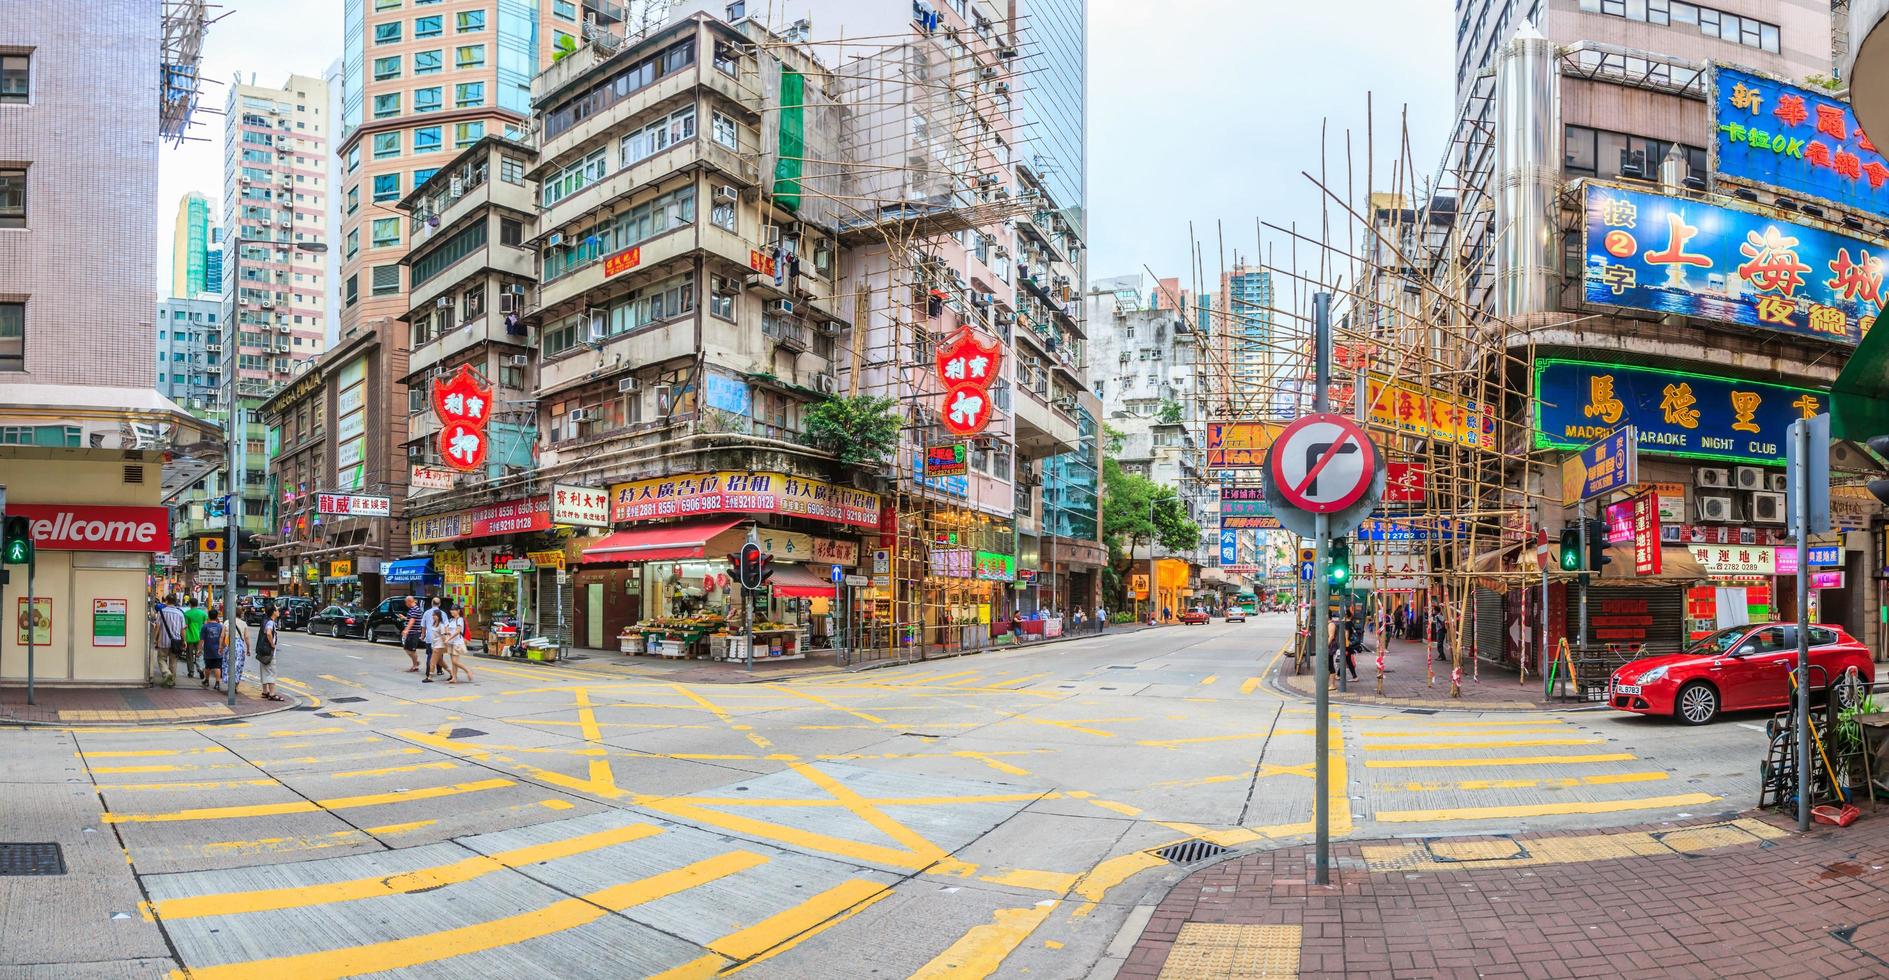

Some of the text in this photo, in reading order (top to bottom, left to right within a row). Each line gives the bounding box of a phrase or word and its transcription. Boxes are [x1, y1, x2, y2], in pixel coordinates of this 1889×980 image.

[950, 391, 983, 427] 押
[1368, 386, 1465, 429] 上海城市
[448, 426, 480, 464] 押
[1701, 437, 1735, 451] NIGHT
[1748, 441, 1777, 455] CLUB
[618, 474, 771, 503] 特大廣告位 招租
[785, 478, 876, 511] 特大廣告位招租
[319, 495, 350, 513] 龍威
[484, 508, 498, 520] 2881
[498, 506, 514, 518] 8556
[518, 503, 533, 515] 6906
[640, 503, 656, 516] 2881
[658, 500, 676, 514] 8556
[682, 497, 700, 512] 6906
[701, 495, 721, 510] 9882
[738, 496, 756, 508] 9218
[757, 495, 774, 508] 0128
[807, 502, 824, 517] 6906
[846, 508, 861, 522] 9218
[862, 510, 877, 524] 0128
[500, 519, 515, 531] 9218
[515, 517, 532, 529] 0128
[1697, 548, 1769, 563] 興運地產
